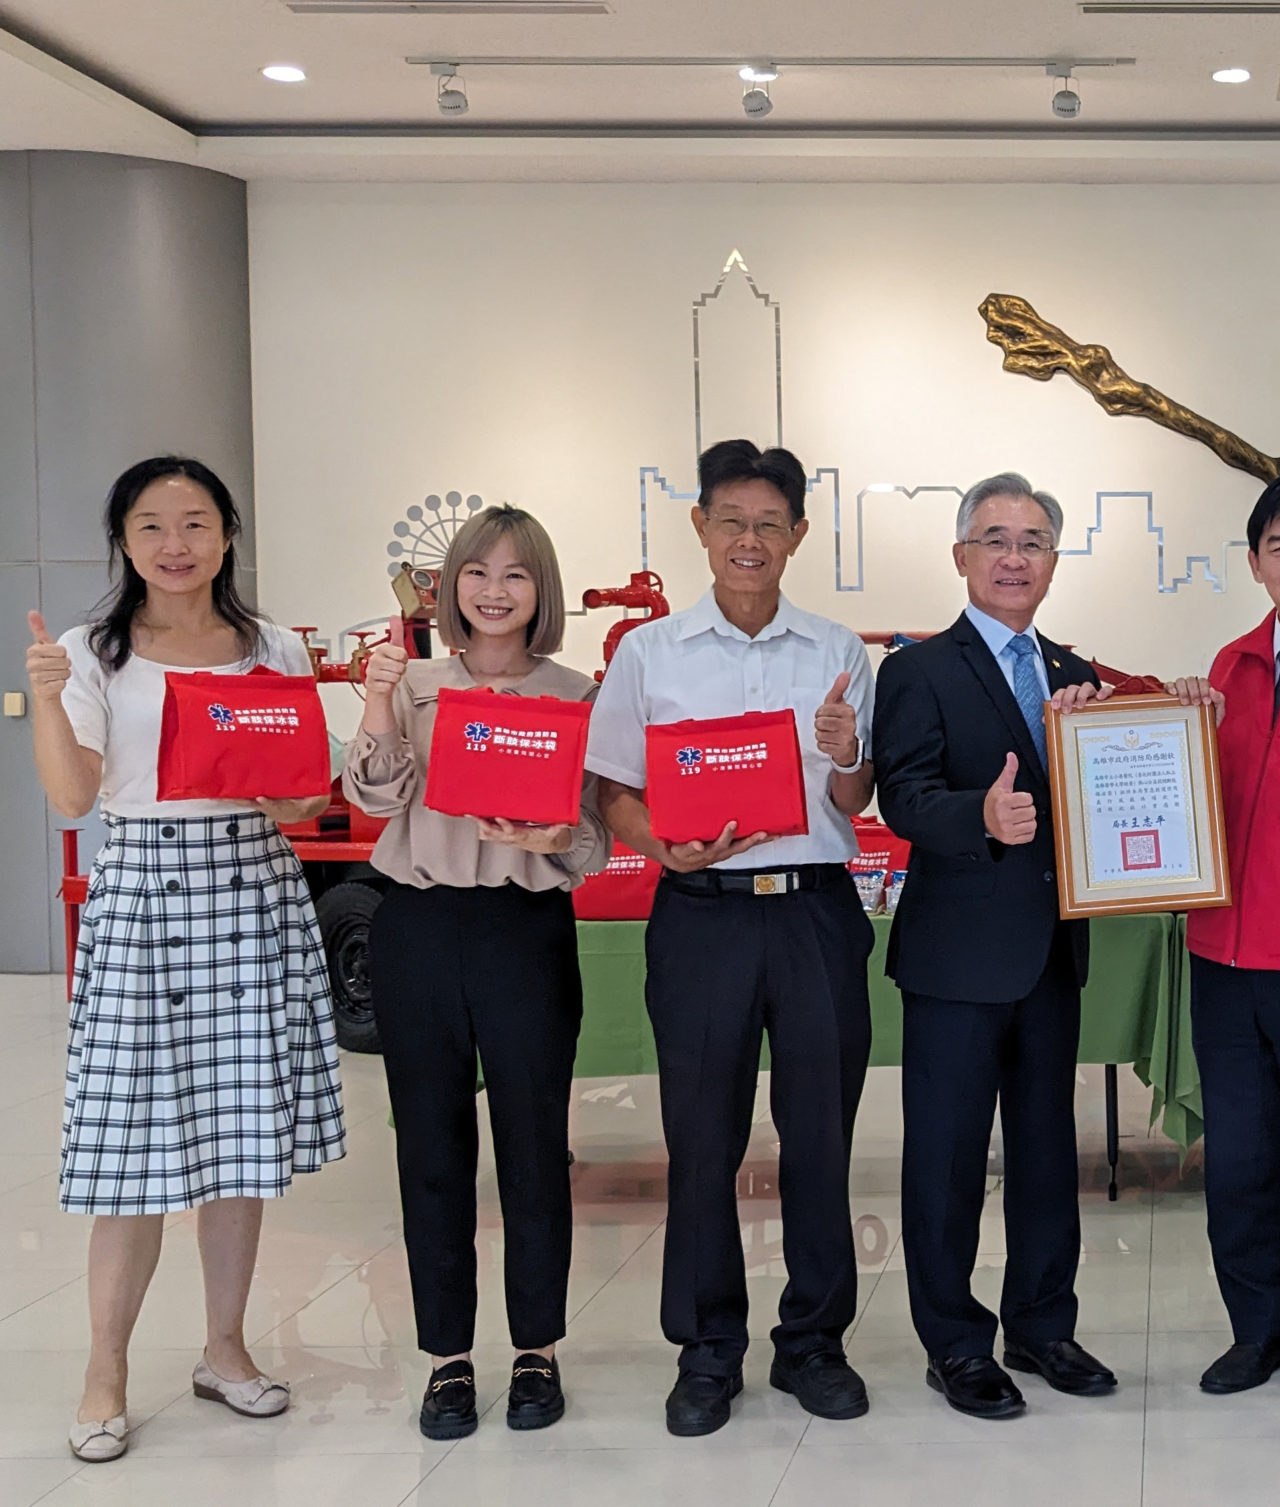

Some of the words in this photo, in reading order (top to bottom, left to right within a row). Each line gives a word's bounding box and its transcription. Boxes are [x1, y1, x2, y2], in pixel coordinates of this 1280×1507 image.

[466, 742, 487, 752] 119
[493, 735, 557, 751] 斷肢保冰袋
[705, 751, 768, 764] 斷肢保冰袋
[680, 767, 701, 776] 119
